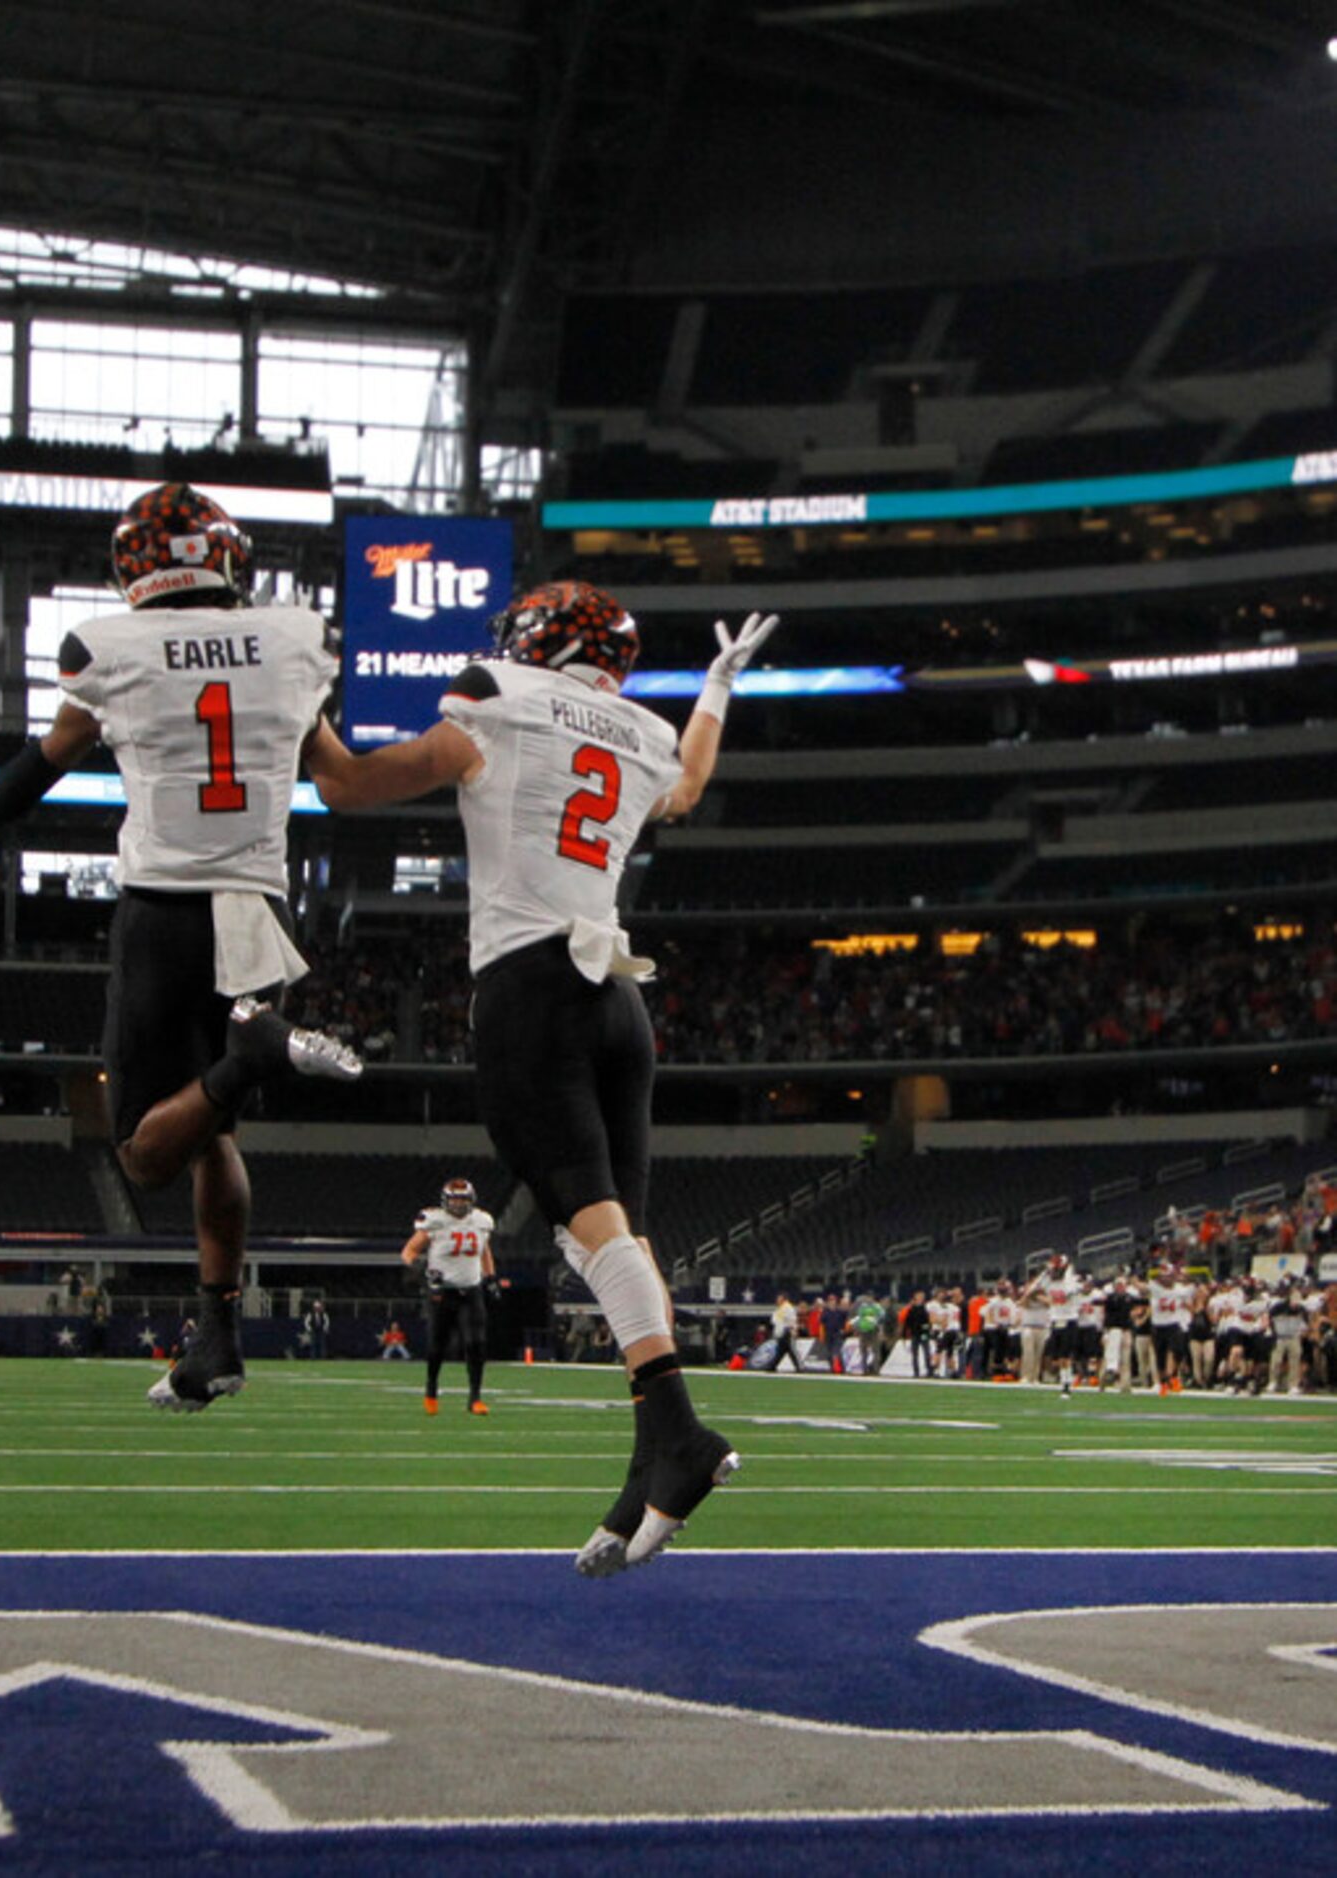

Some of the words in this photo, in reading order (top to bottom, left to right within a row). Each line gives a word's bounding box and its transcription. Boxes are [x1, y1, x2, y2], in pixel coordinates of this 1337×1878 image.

[710, 498, 765, 526] AT&T
[769, 494, 867, 523] STADIUM
[390, 559, 490, 620] Lite
[164, 636, 262, 670] EARLE
[355, 652, 382, 677] 21
[195, 681, 248, 814] 1
[551, 697, 640, 753] PELLEGRINO
[557, 743, 622, 871] 2
[451, 1231, 478, 1257] 73
